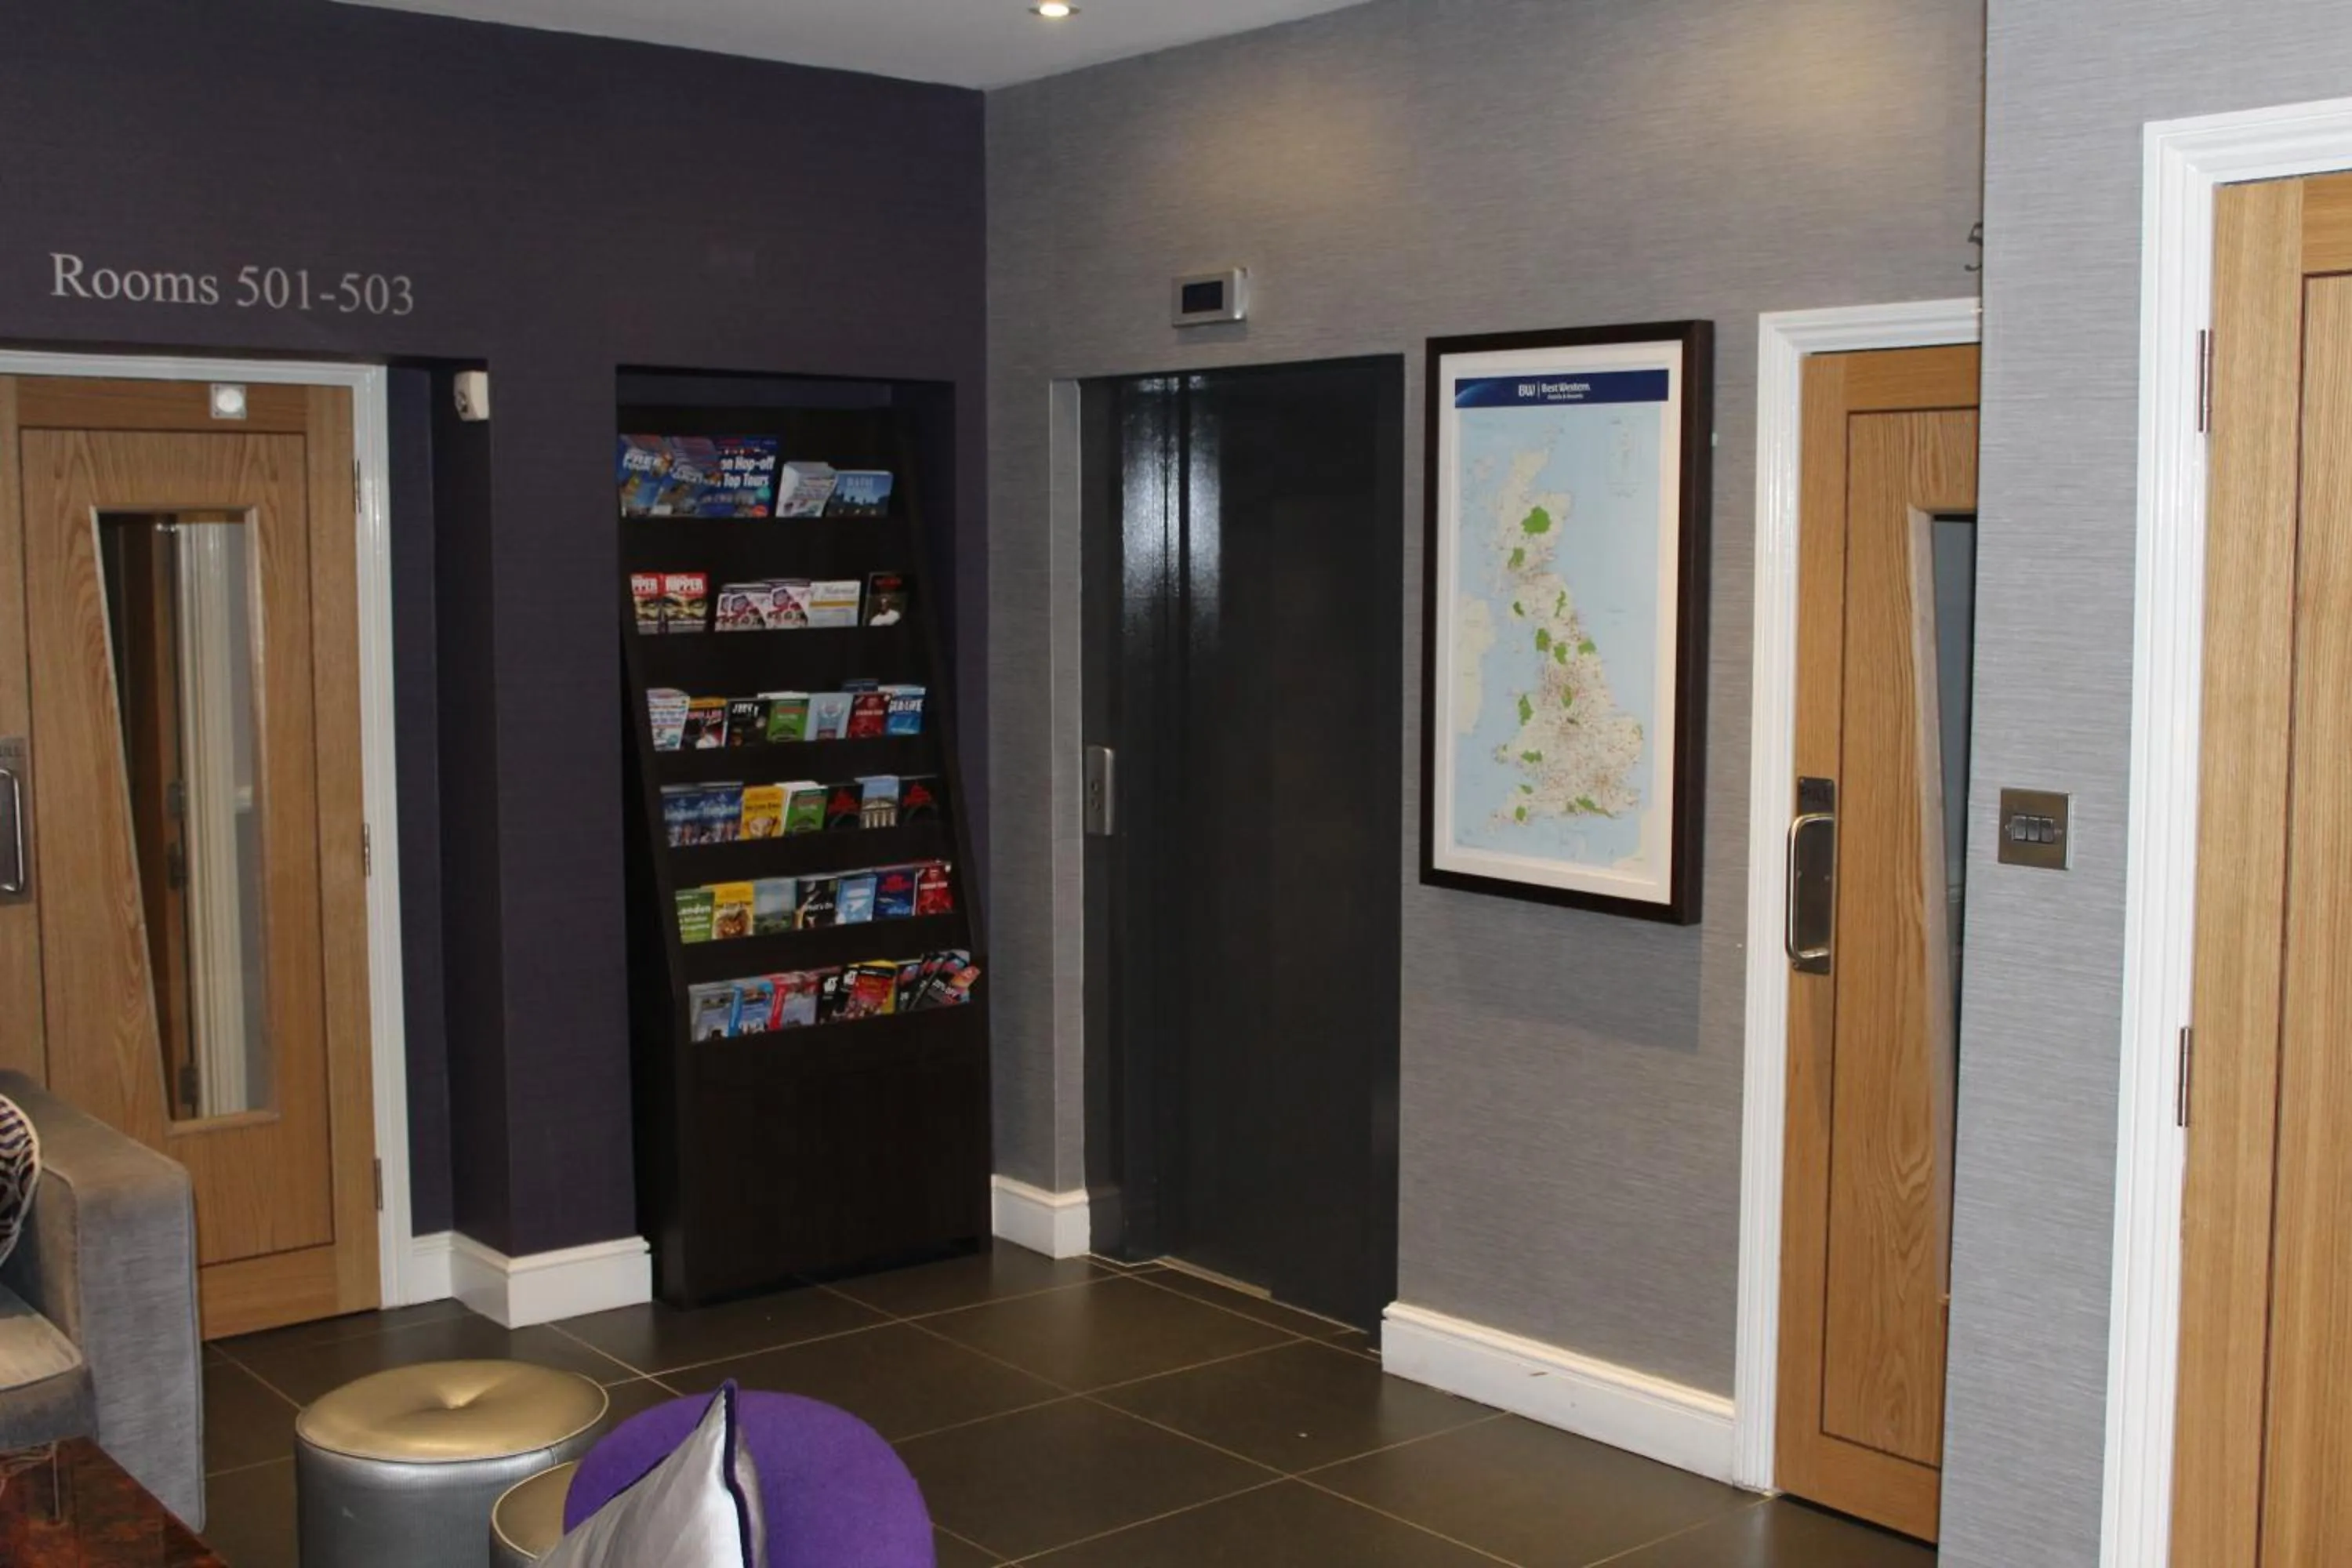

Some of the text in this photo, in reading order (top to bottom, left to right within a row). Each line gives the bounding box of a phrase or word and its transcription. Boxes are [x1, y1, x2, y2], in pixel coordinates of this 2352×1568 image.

[49, 252, 414, 315] Rooms 501-503
[1541, 383, 1558, 393] Best
[1558, 382, 1591, 392] Western
[735, 456, 776, 472] Hop-off
